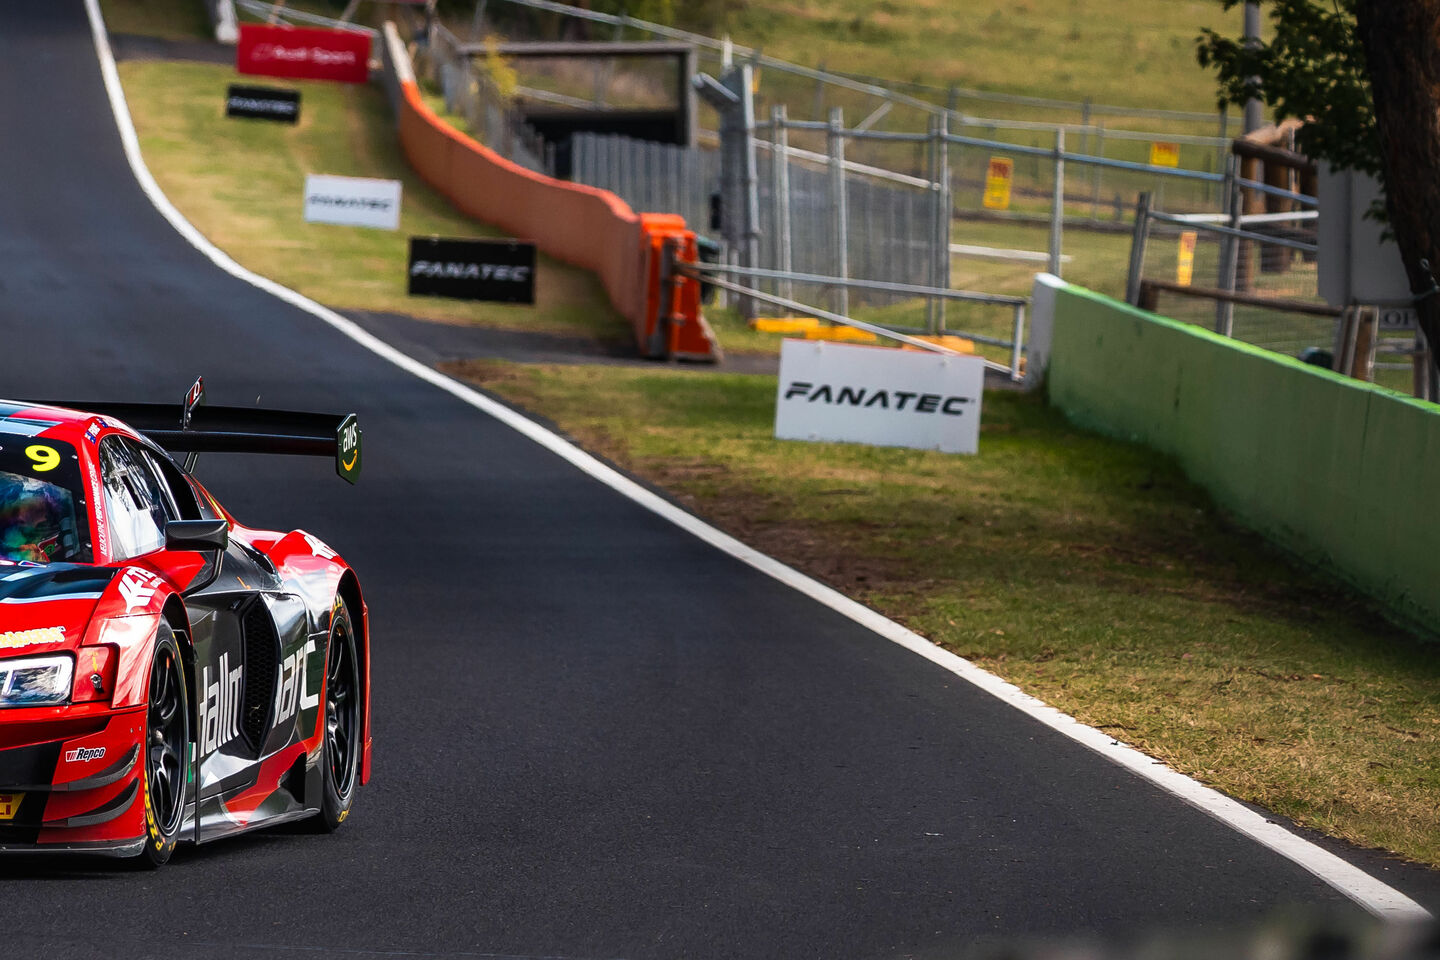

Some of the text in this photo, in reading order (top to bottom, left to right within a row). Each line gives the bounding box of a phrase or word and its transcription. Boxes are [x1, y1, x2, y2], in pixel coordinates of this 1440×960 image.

[412, 260, 530, 282] FANATEC
[785, 381, 970, 416] FANATEC
[343, 422, 357, 453] aws
[24, 444, 61, 472] 9
[76, 747, 106, 762] Repco
